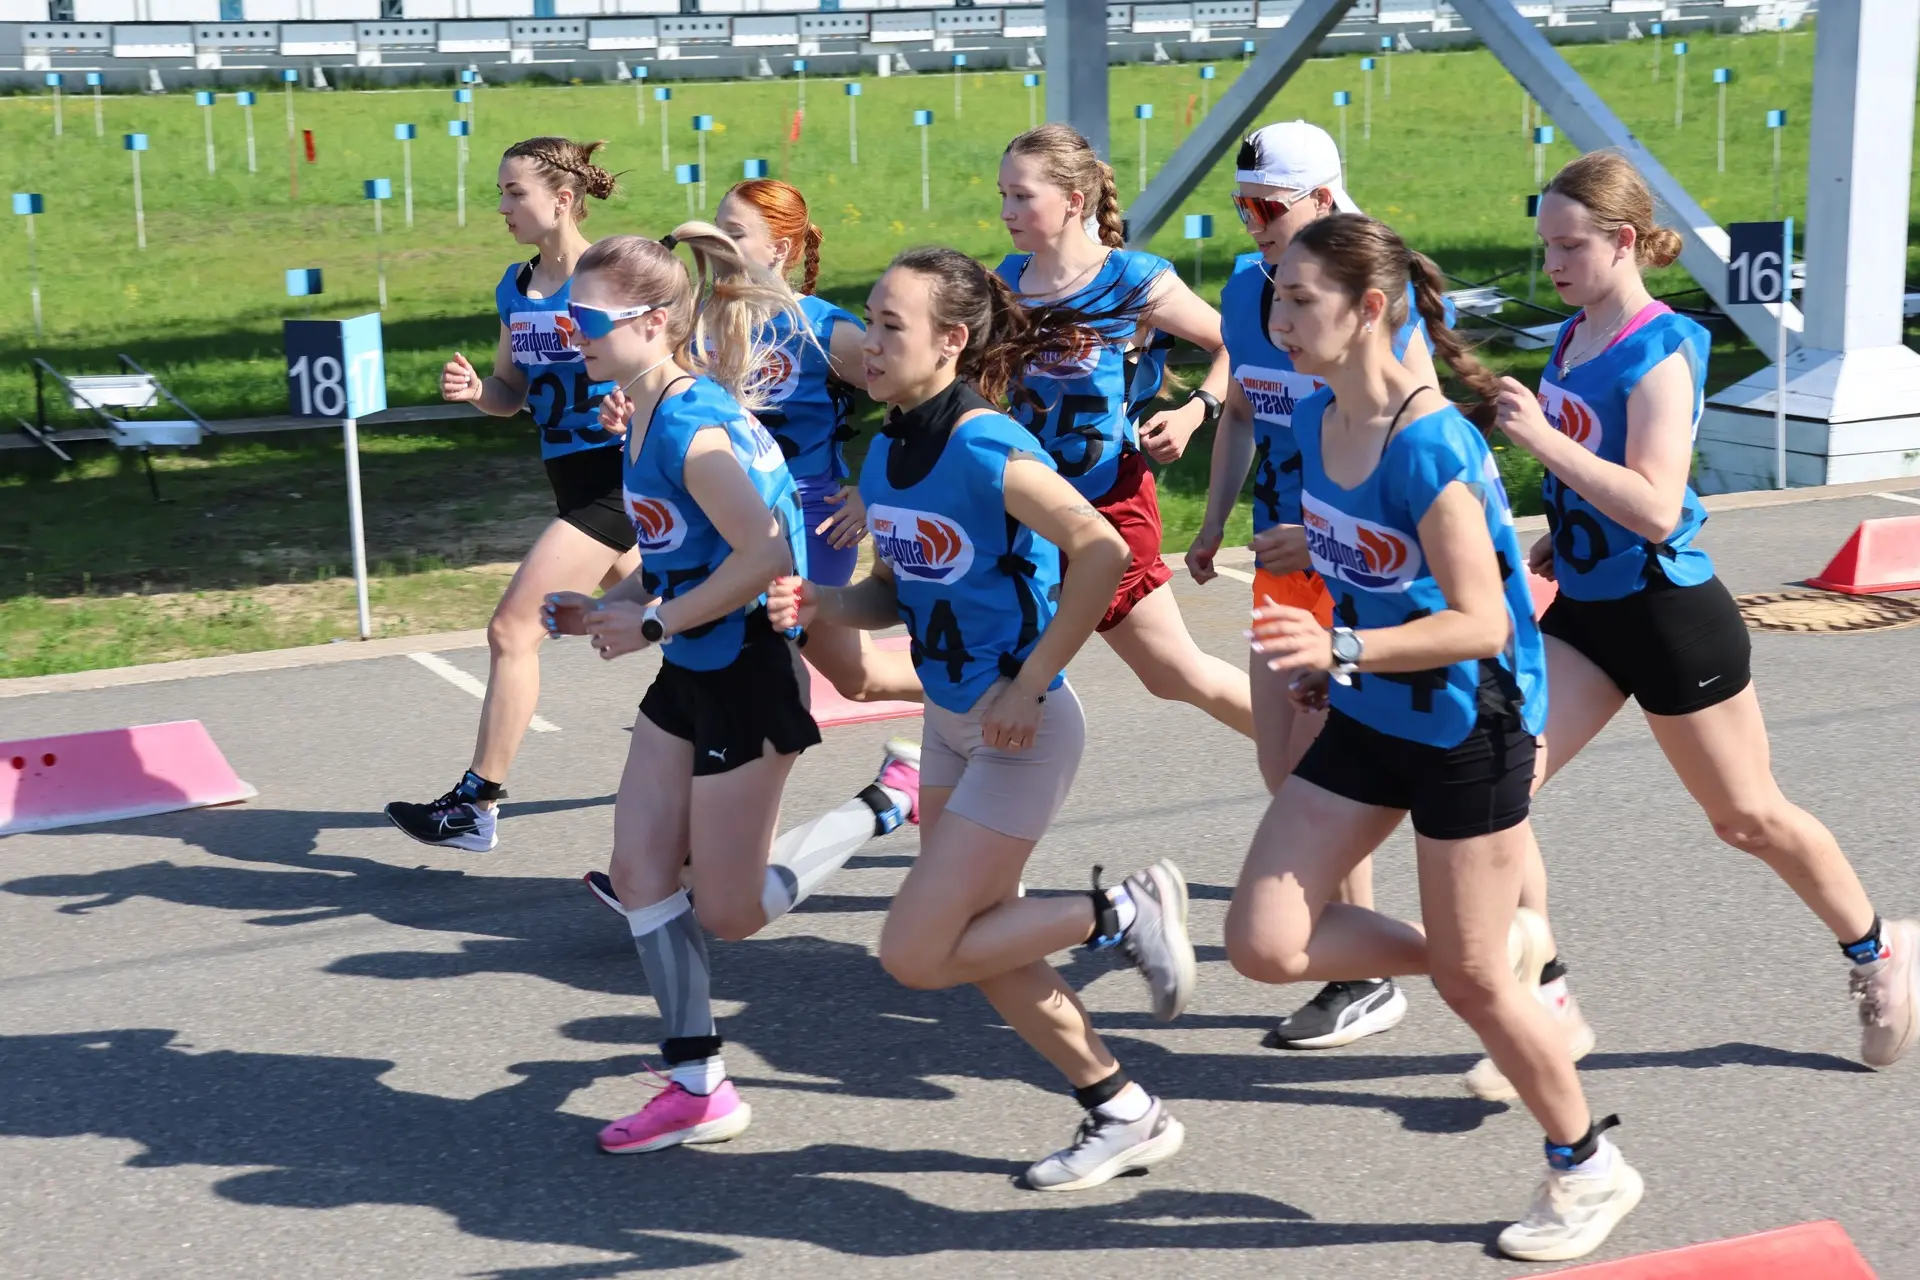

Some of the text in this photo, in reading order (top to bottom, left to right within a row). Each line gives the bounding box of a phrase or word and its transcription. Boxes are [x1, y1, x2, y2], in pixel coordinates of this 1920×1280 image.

[1729, 251, 1782, 302] 16
[289, 355, 346, 416] 18
[349, 349, 380, 414] 17
[528, 372, 628, 444] 25
